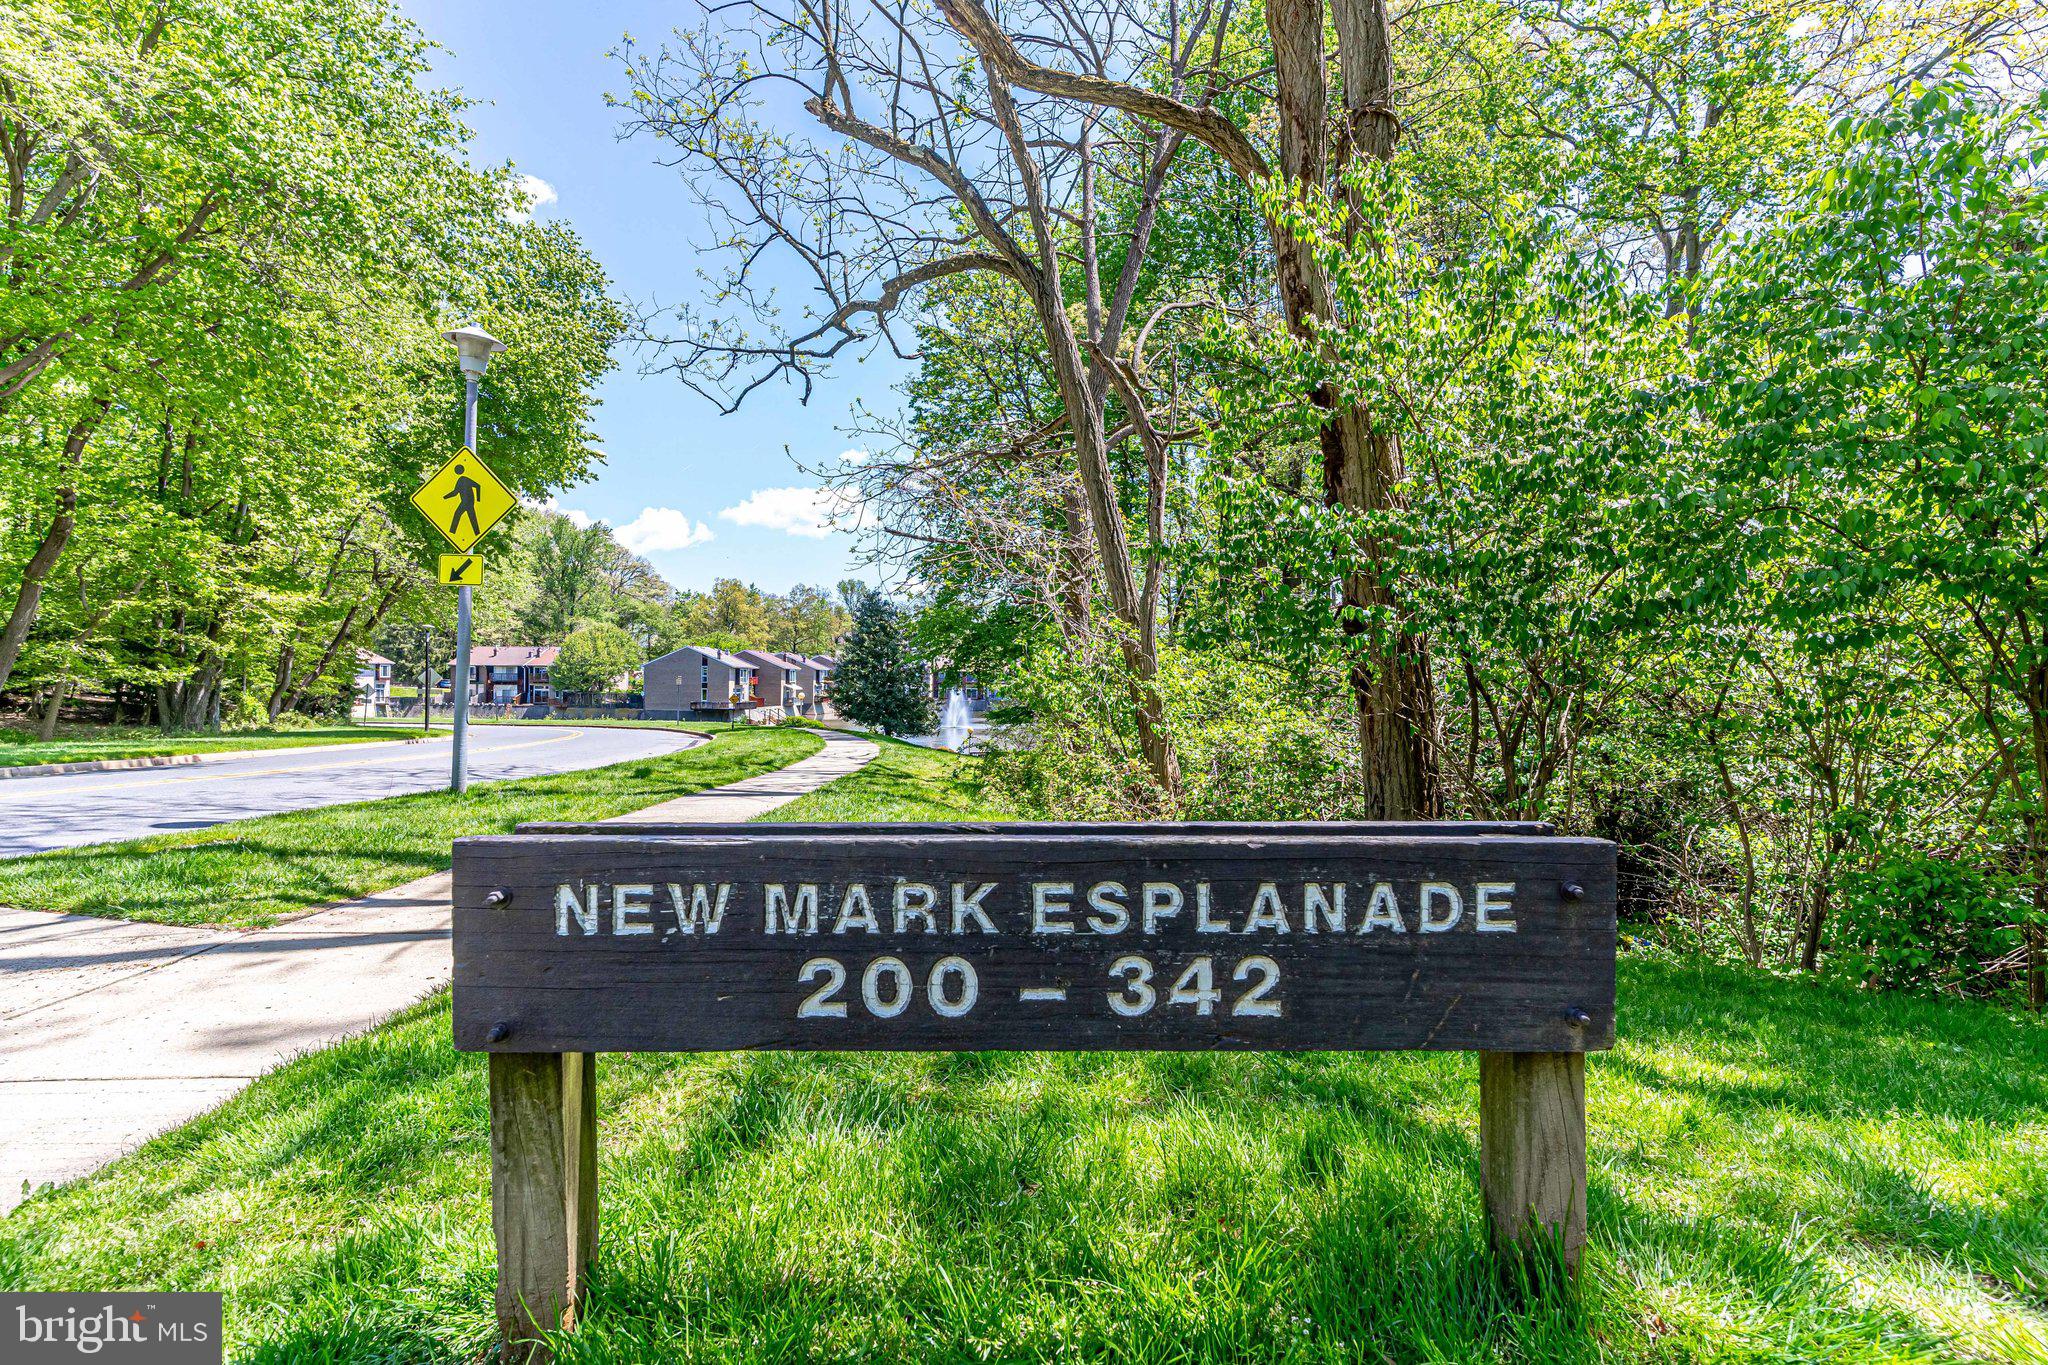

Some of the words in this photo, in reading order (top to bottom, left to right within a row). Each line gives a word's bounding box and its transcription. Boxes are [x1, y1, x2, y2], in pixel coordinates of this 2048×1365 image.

[555, 882, 733, 936] NEW
[763, 882, 1000, 936] MARK
[1030, 880, 1518, 936] ESPLANADE
[796, 955, 980, 1019] 200
[1107, 955, 1284, 1018] 342
